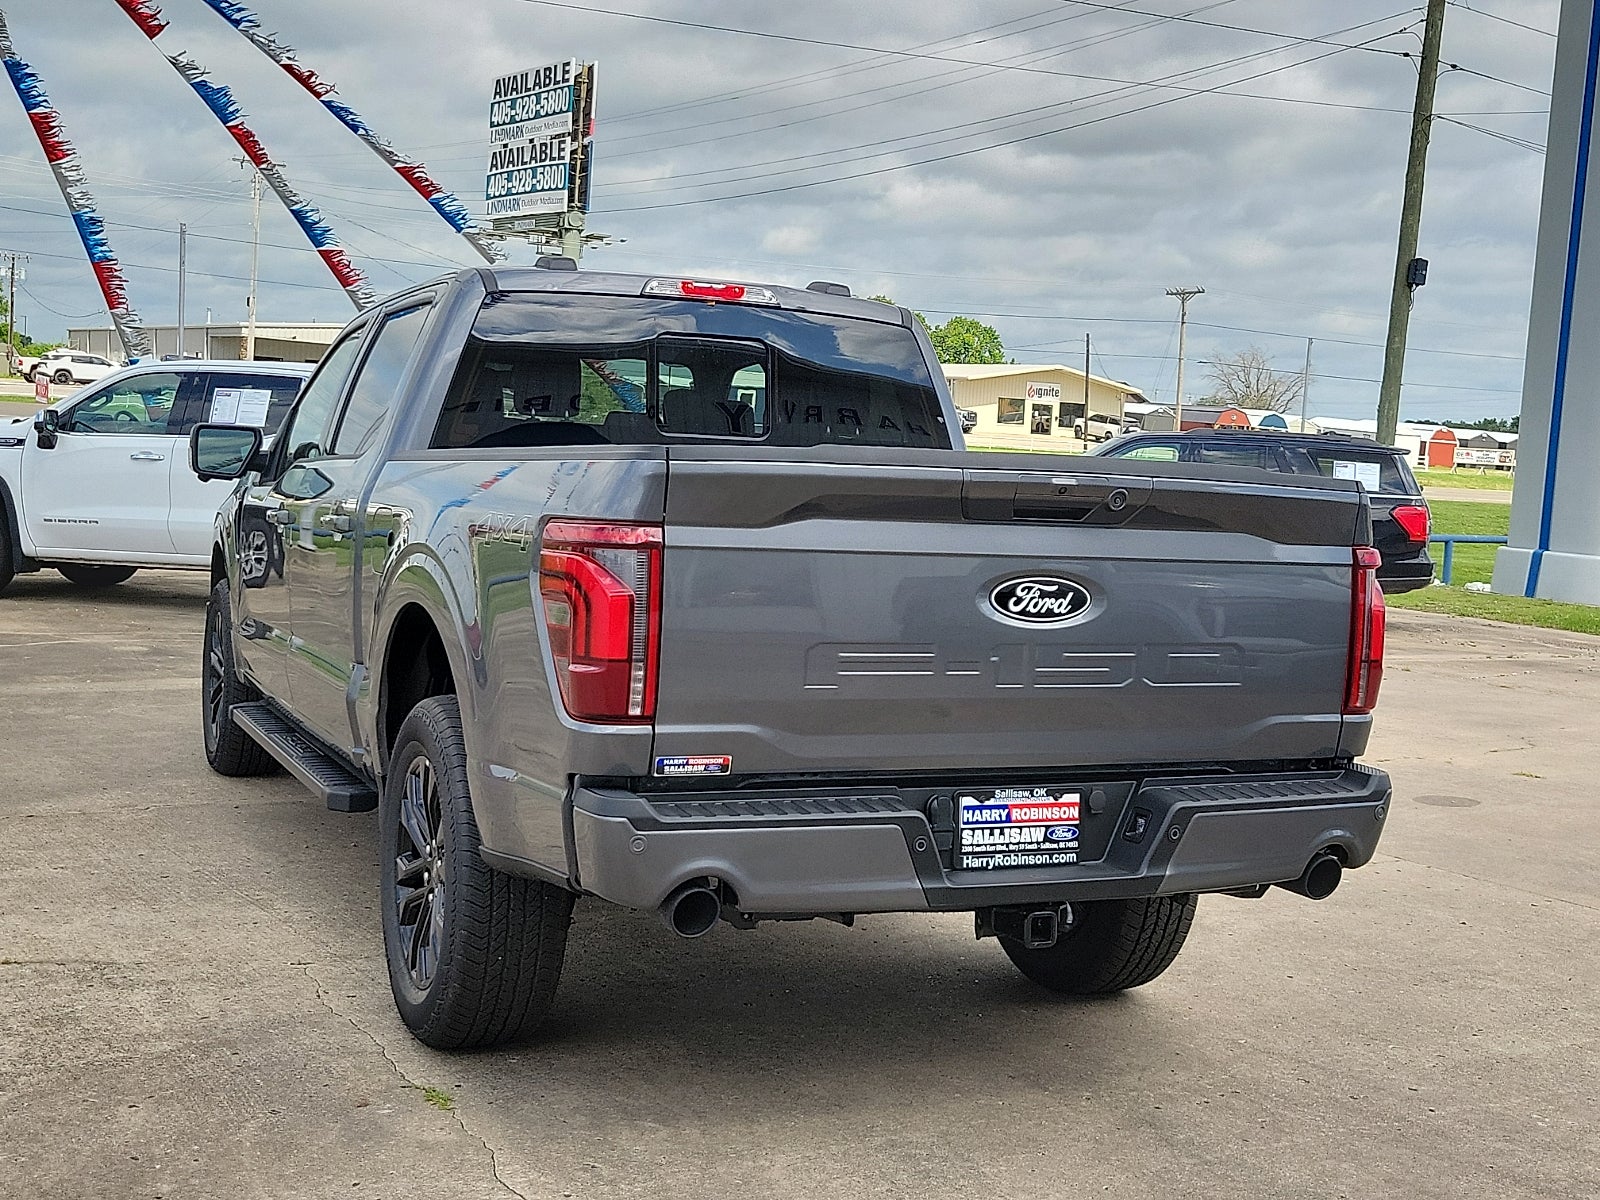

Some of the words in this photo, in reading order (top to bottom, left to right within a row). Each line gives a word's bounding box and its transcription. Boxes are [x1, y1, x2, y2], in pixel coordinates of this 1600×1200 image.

[493, 61, 571, 100] AVAILABLE
[491, 88, 570, 126] 405-928-5800
[490, 125, 525, 144] LINDMARK
[524, 125, 543, 135] Outdoor
[489, 139, 567, 172] AVAILABLE
[487, 165, 565, 198] 405-928-5800
[487, 198, 522, 215] LINDMARK
[521, 198, 539, 208] Outdoor
[1035, 386, 1060, 398] ignite
[1007, 582, 1075, 615] Ford
[803, 640, 1245, 691] F-150
[688, 757, 724, 765] ROBINSON
[994, 789, 1032, 799] Sallisaw,
[1033, 788, 1047, 797] OK
[963, 808, 1009, 822] HARRY
[1011, 806, 1079, 821] ROBINSON
[961, 827, 1046, 845] SALLISAW
[1052, 828, 1073, 838] Ford
[963, 853, 1077, 869] HarryRobinson.com
